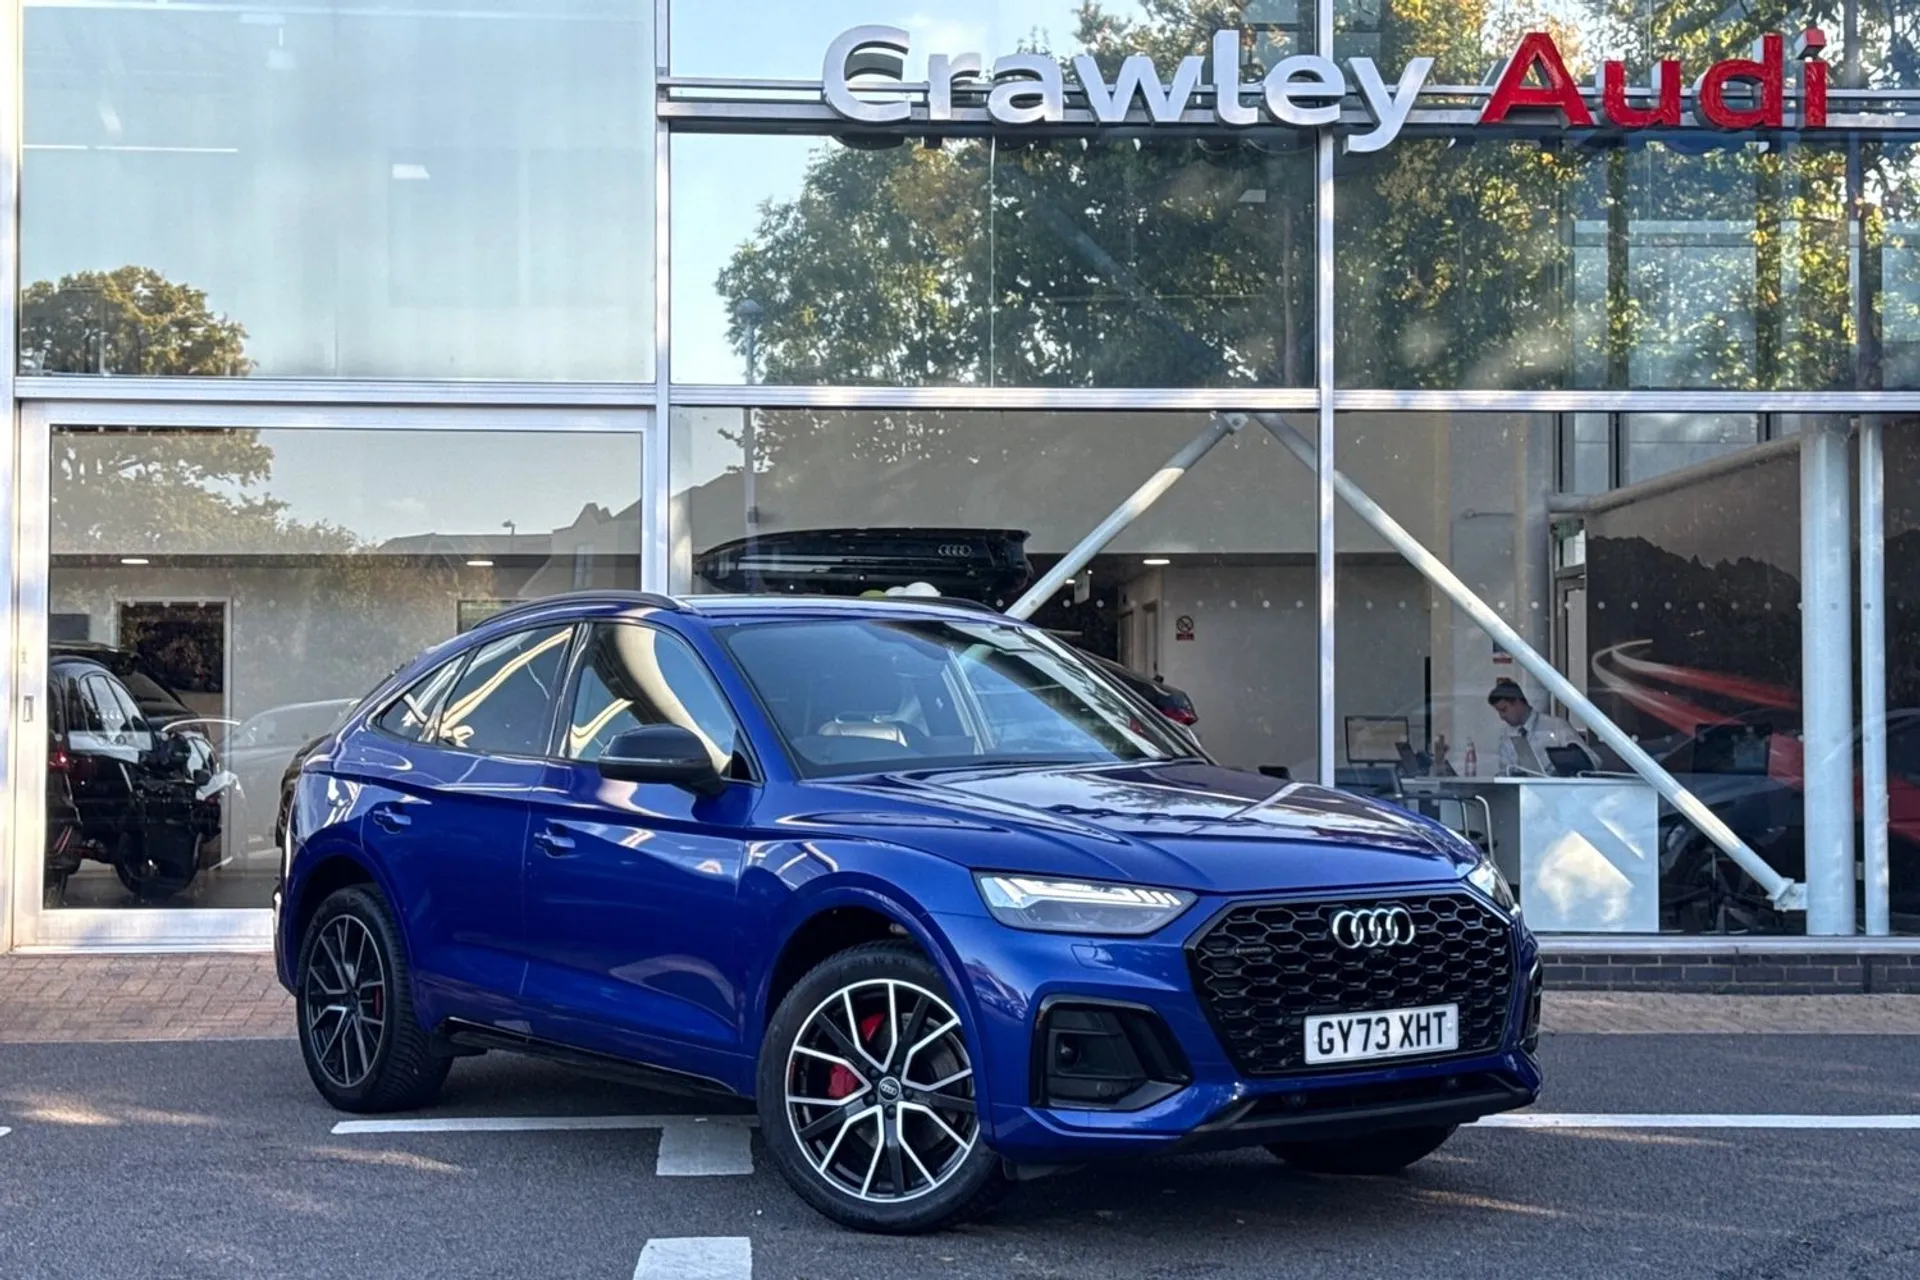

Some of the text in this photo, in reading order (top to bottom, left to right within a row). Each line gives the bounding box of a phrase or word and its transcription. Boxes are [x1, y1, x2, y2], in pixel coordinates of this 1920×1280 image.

[822, 24, 1828, 155] Crawley Audi
[1317, 1011, 1447, 1055] GY73 XHT
